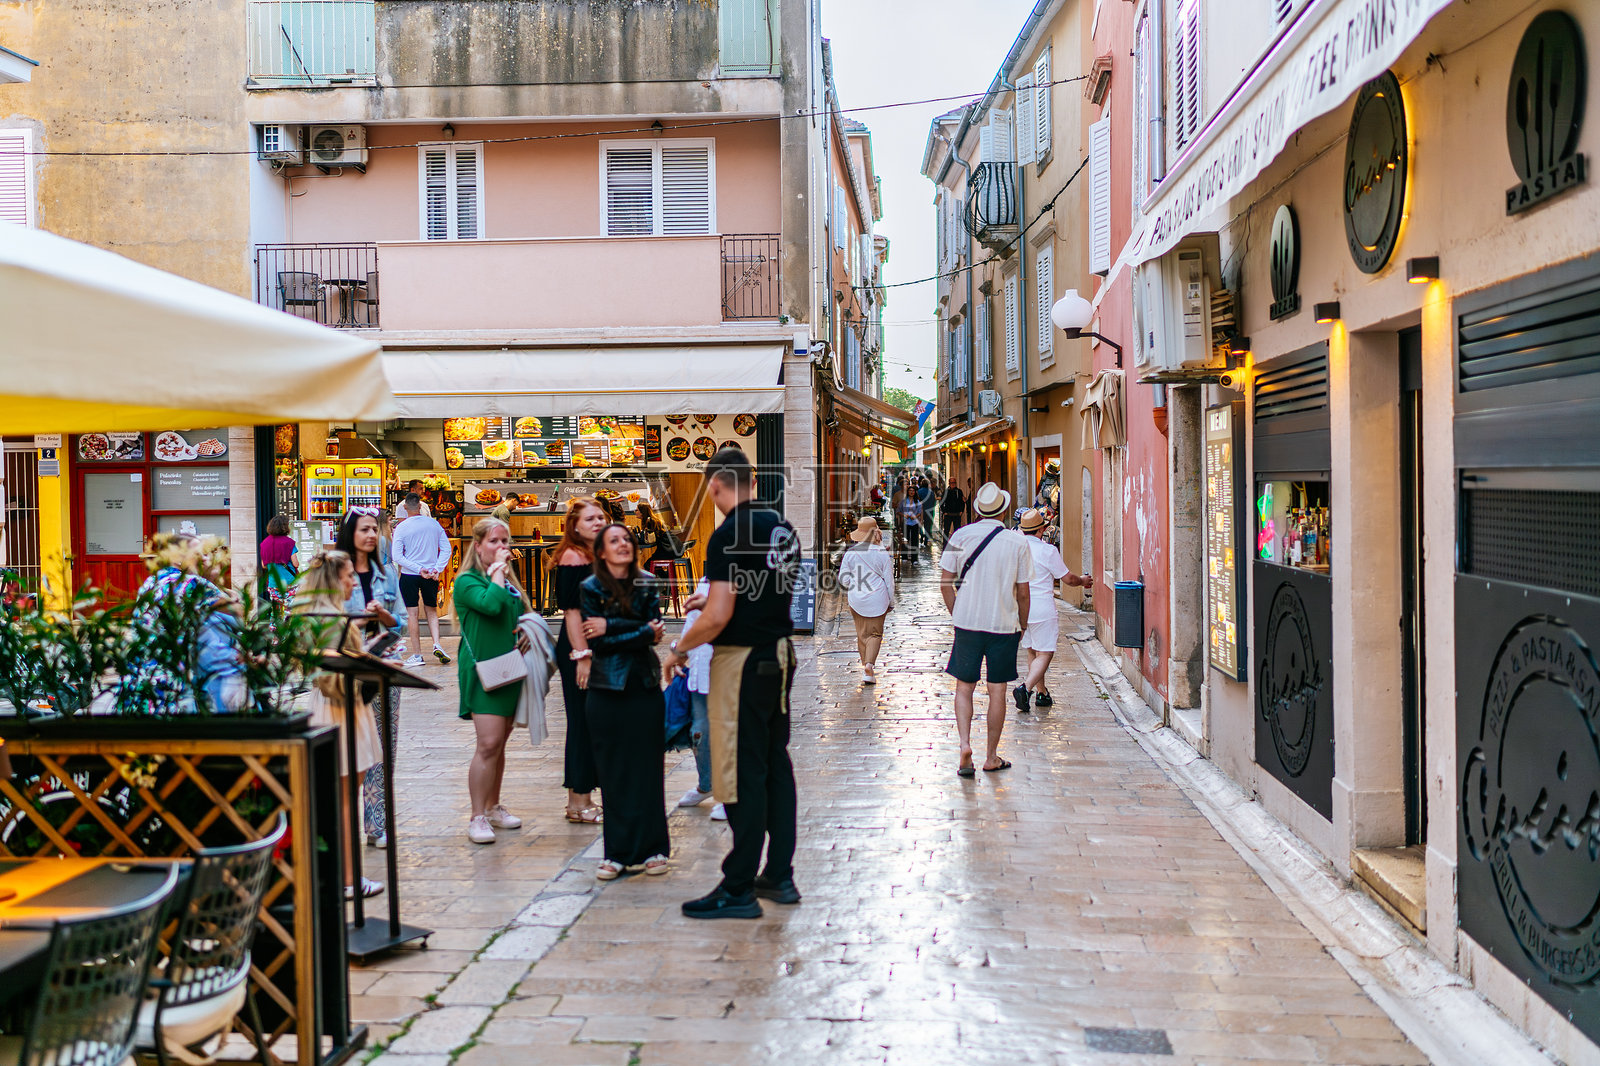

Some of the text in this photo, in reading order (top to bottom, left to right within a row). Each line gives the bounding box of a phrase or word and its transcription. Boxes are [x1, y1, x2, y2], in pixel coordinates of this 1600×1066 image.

[1507, 162, 1576, 210] PASTA
[1210, 411, 1227, 431] MENU
[46, 449, 51, 458] 2
[1489, 671, 1510, 739] PIZZA
[1511, 653, 1521, 674] &
[1522, 636, 1564, 667] PASTA
[1566, 651, 1577, 681] &
[1494, 846, 1518, 919] GRILL
[1528, 926, 1587, 976] BURGERS
